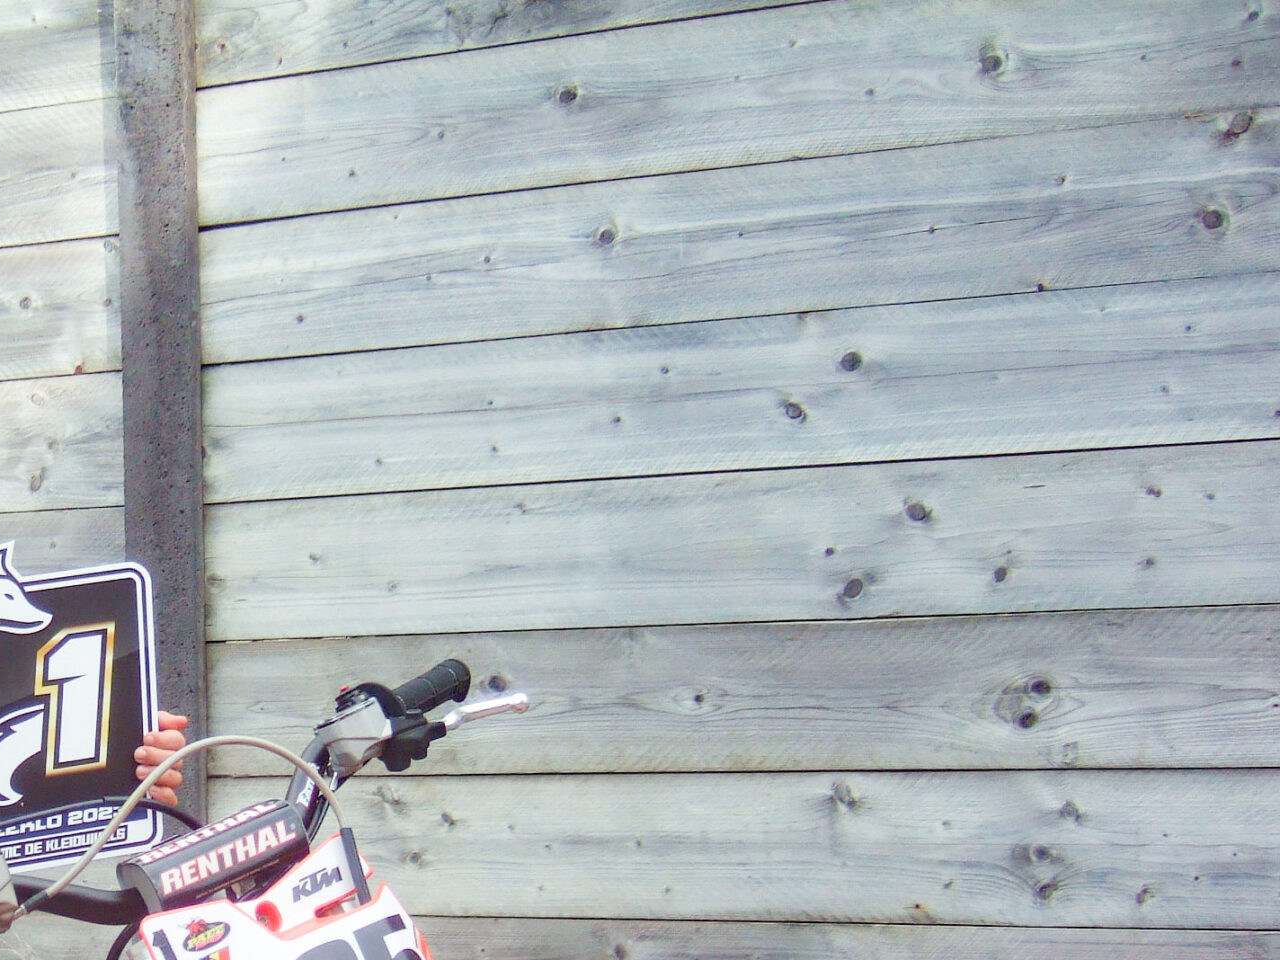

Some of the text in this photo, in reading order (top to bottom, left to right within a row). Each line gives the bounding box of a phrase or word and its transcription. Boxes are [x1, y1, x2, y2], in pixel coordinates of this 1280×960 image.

[34, 621, 116, 777] 1
[24, 843, 43, 856] DE
[161, 820, 296, 895] RENTHAL
[292, 866, 343, 903] KTM
